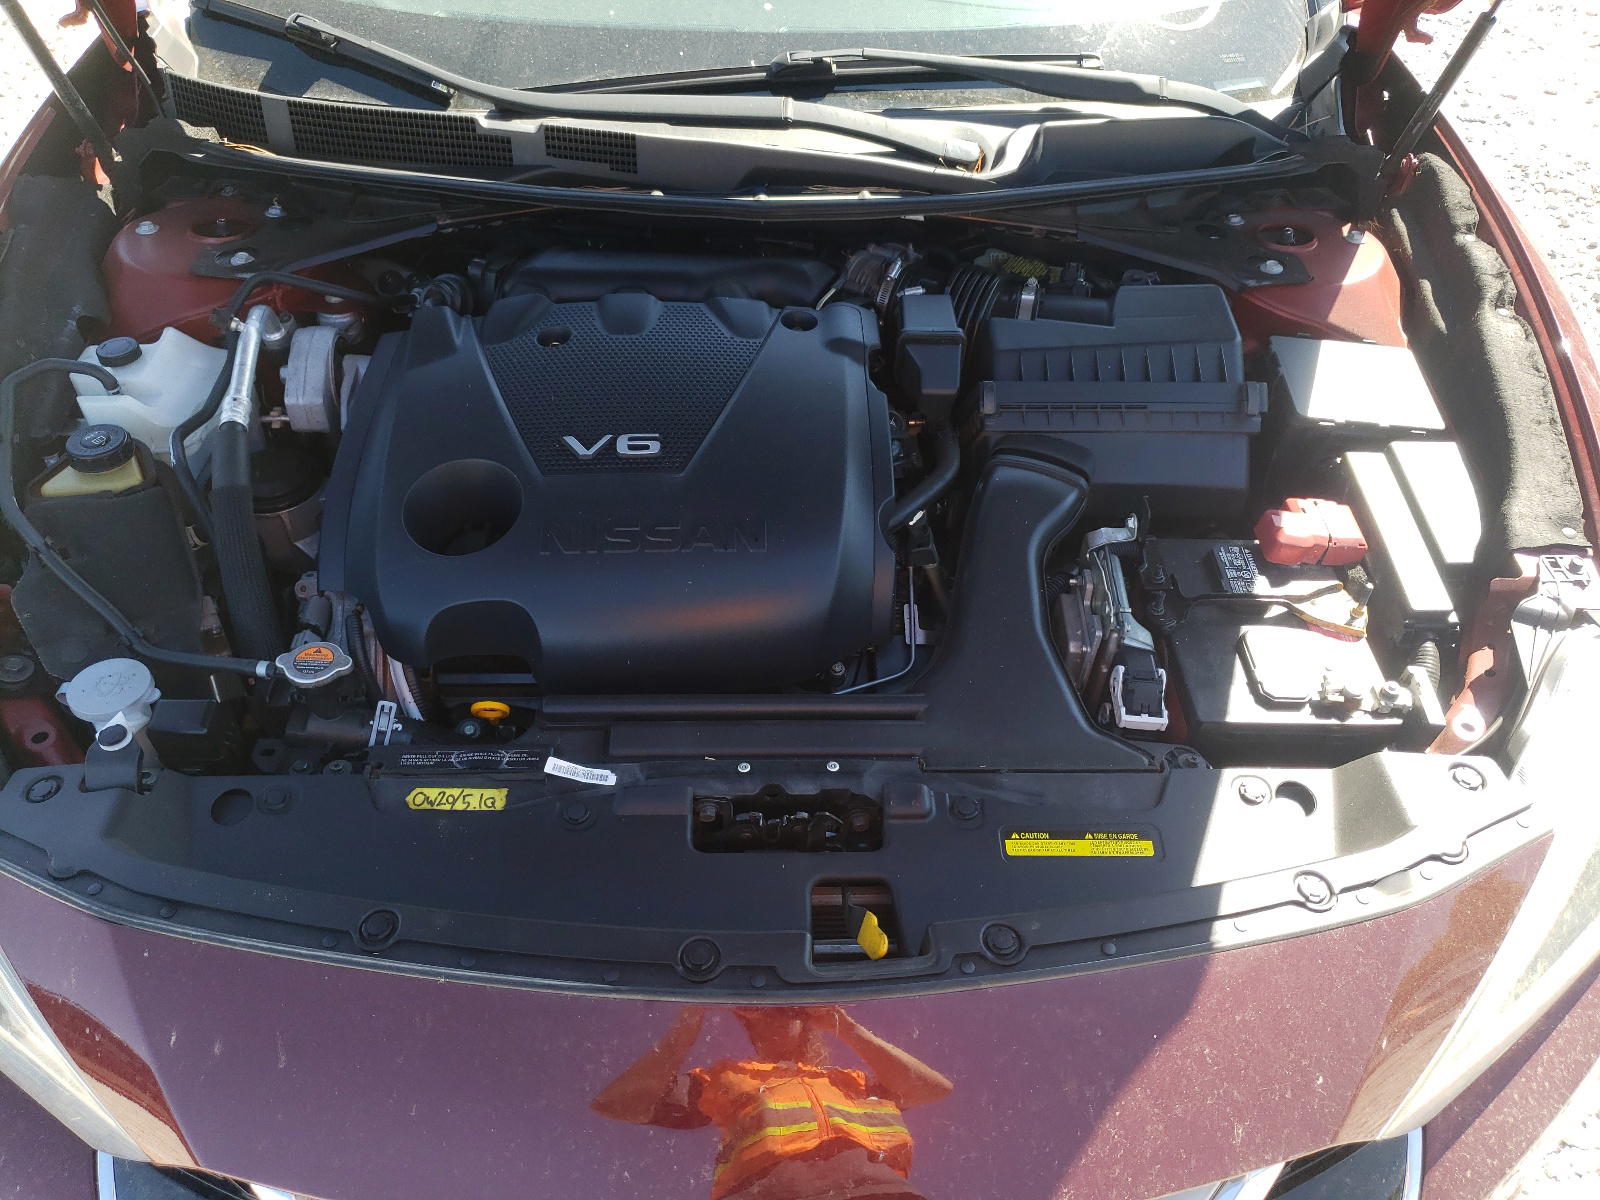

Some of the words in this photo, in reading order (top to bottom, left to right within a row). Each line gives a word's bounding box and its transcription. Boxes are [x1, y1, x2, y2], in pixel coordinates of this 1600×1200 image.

[562, 433, 661, 457] V6
[539, 519, 768, 555] NISSAN
[1020, 832, 1049, 840] CAUTION
